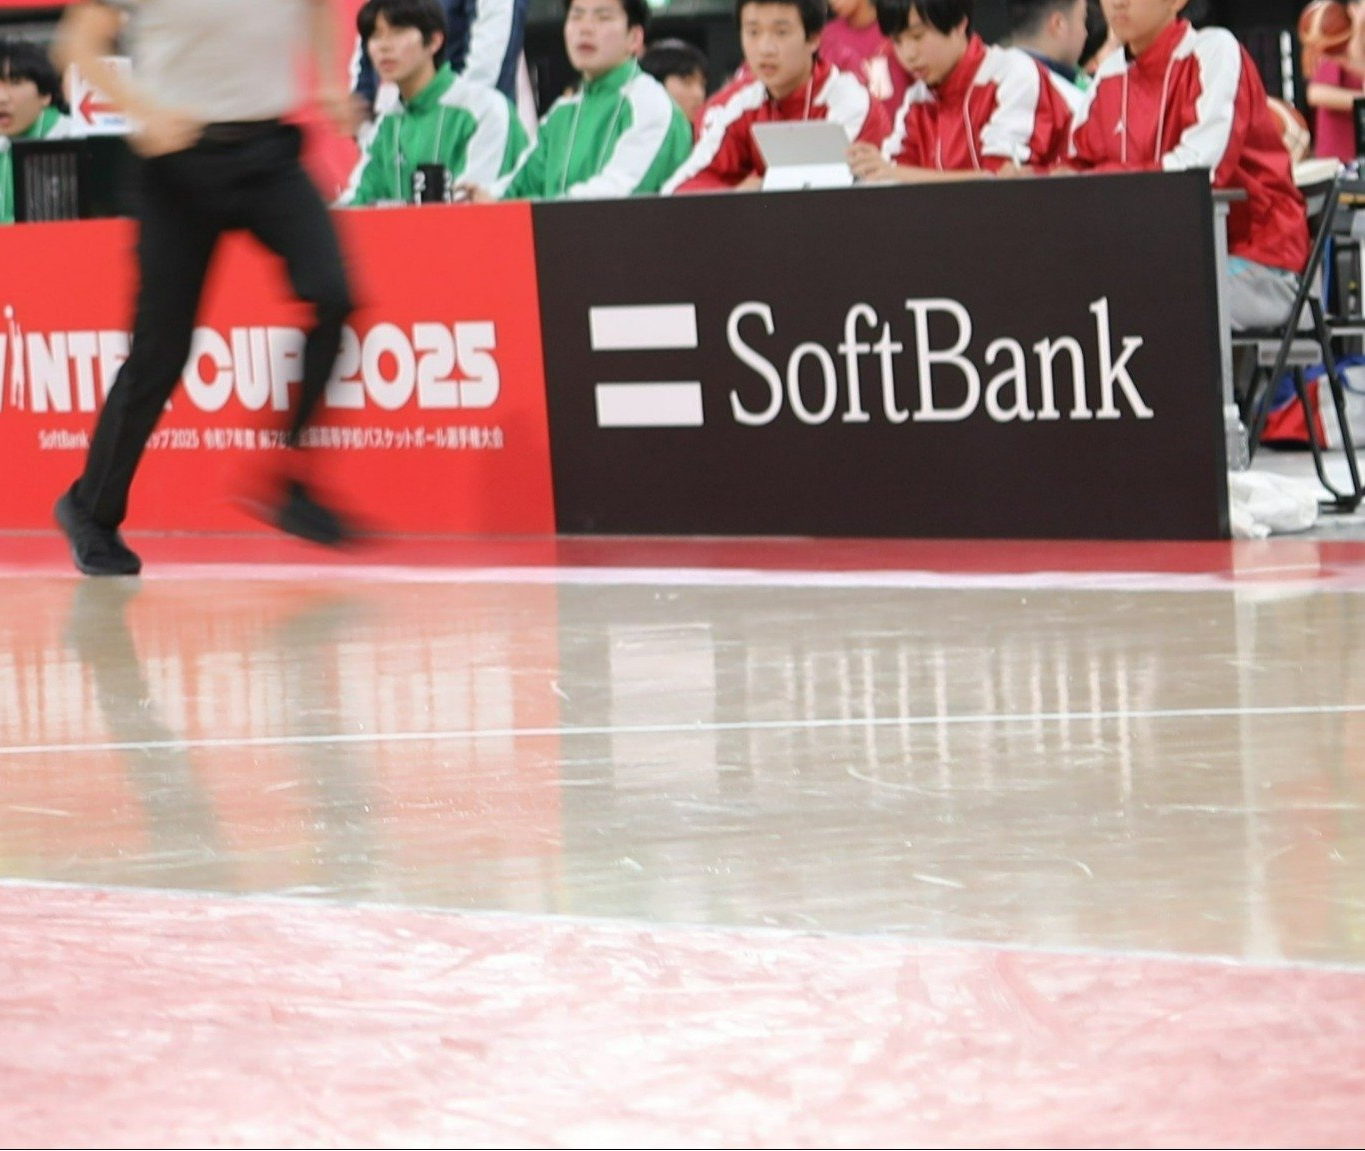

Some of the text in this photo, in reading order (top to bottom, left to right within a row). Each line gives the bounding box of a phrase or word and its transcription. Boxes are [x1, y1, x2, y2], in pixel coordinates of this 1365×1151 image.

[181, 326, 310, 413] CUP
[323, 320, 501, 411] 2025
[726, 296, 1154, 426] SoftBank
